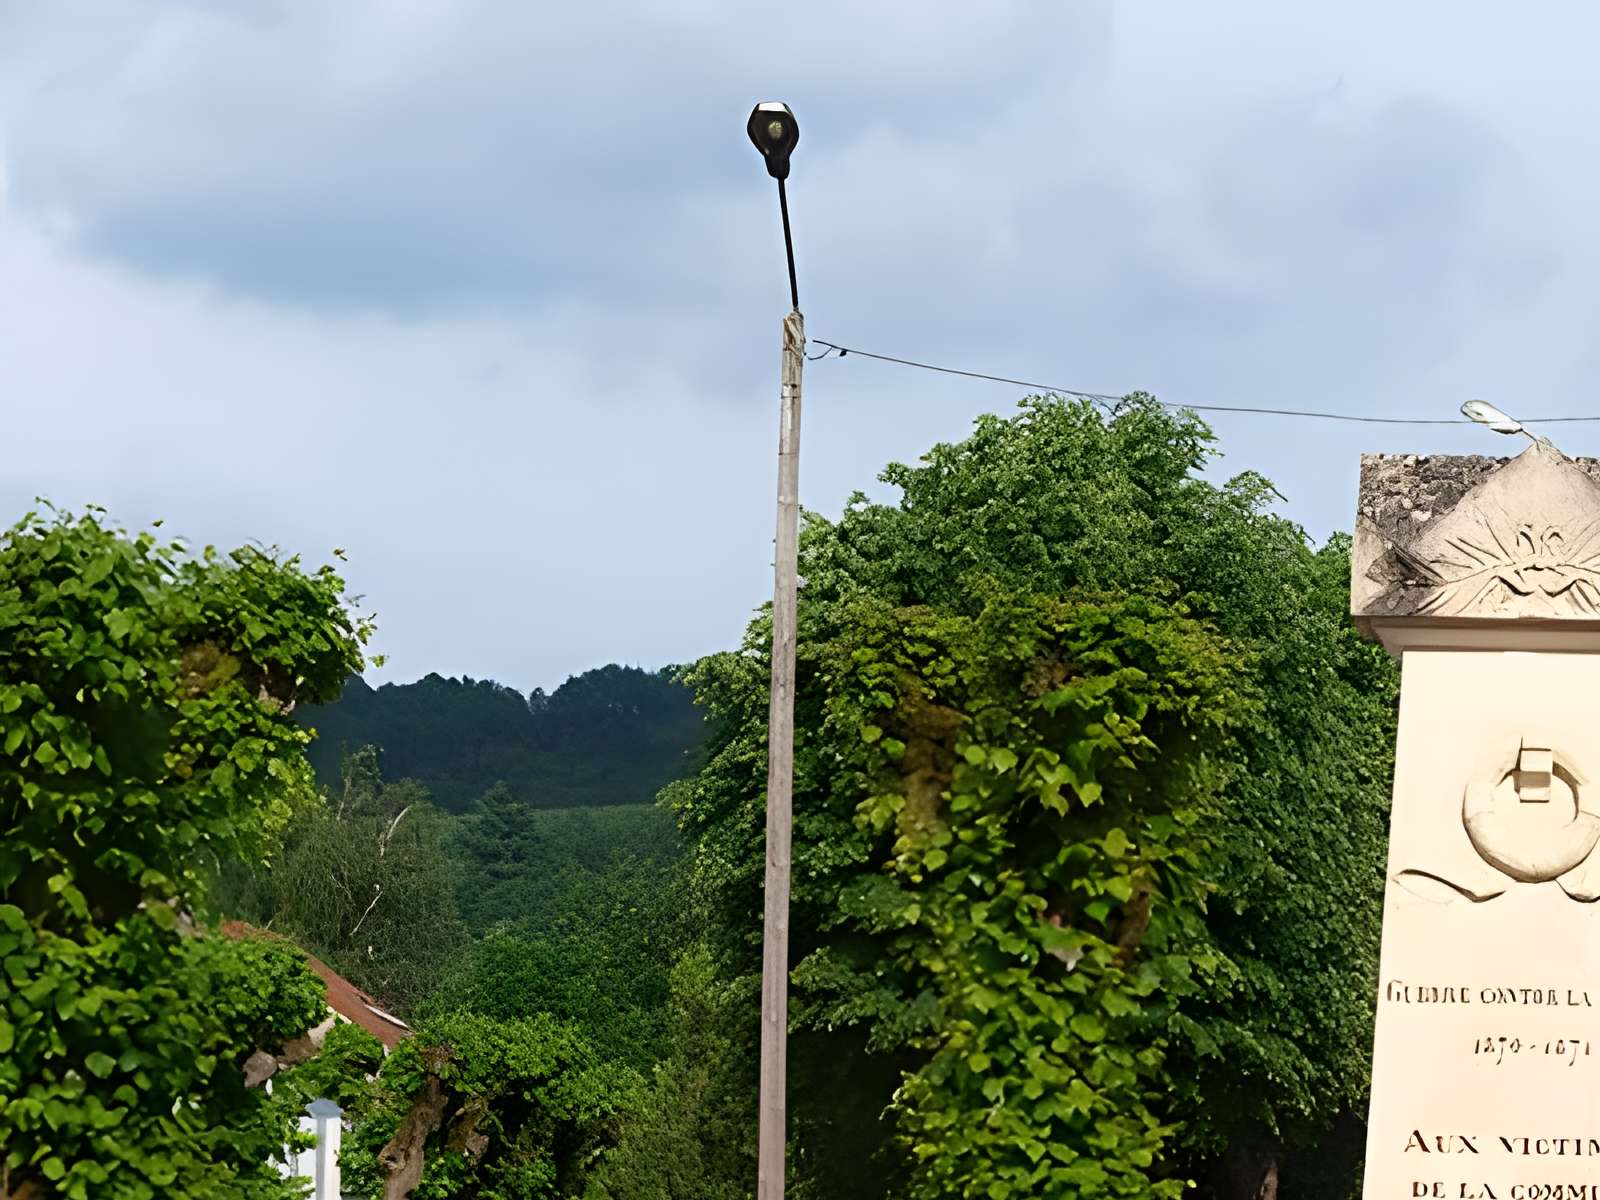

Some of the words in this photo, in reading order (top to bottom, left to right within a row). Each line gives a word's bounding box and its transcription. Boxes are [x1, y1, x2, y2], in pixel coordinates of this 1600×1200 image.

[1567, 989, 1592, 1008] LA
[1403, 1129, 1480, 1154] AUX
[1412, 1181, 1447, 1199] DE
[1459, 1182, 1499, 1200] LA
